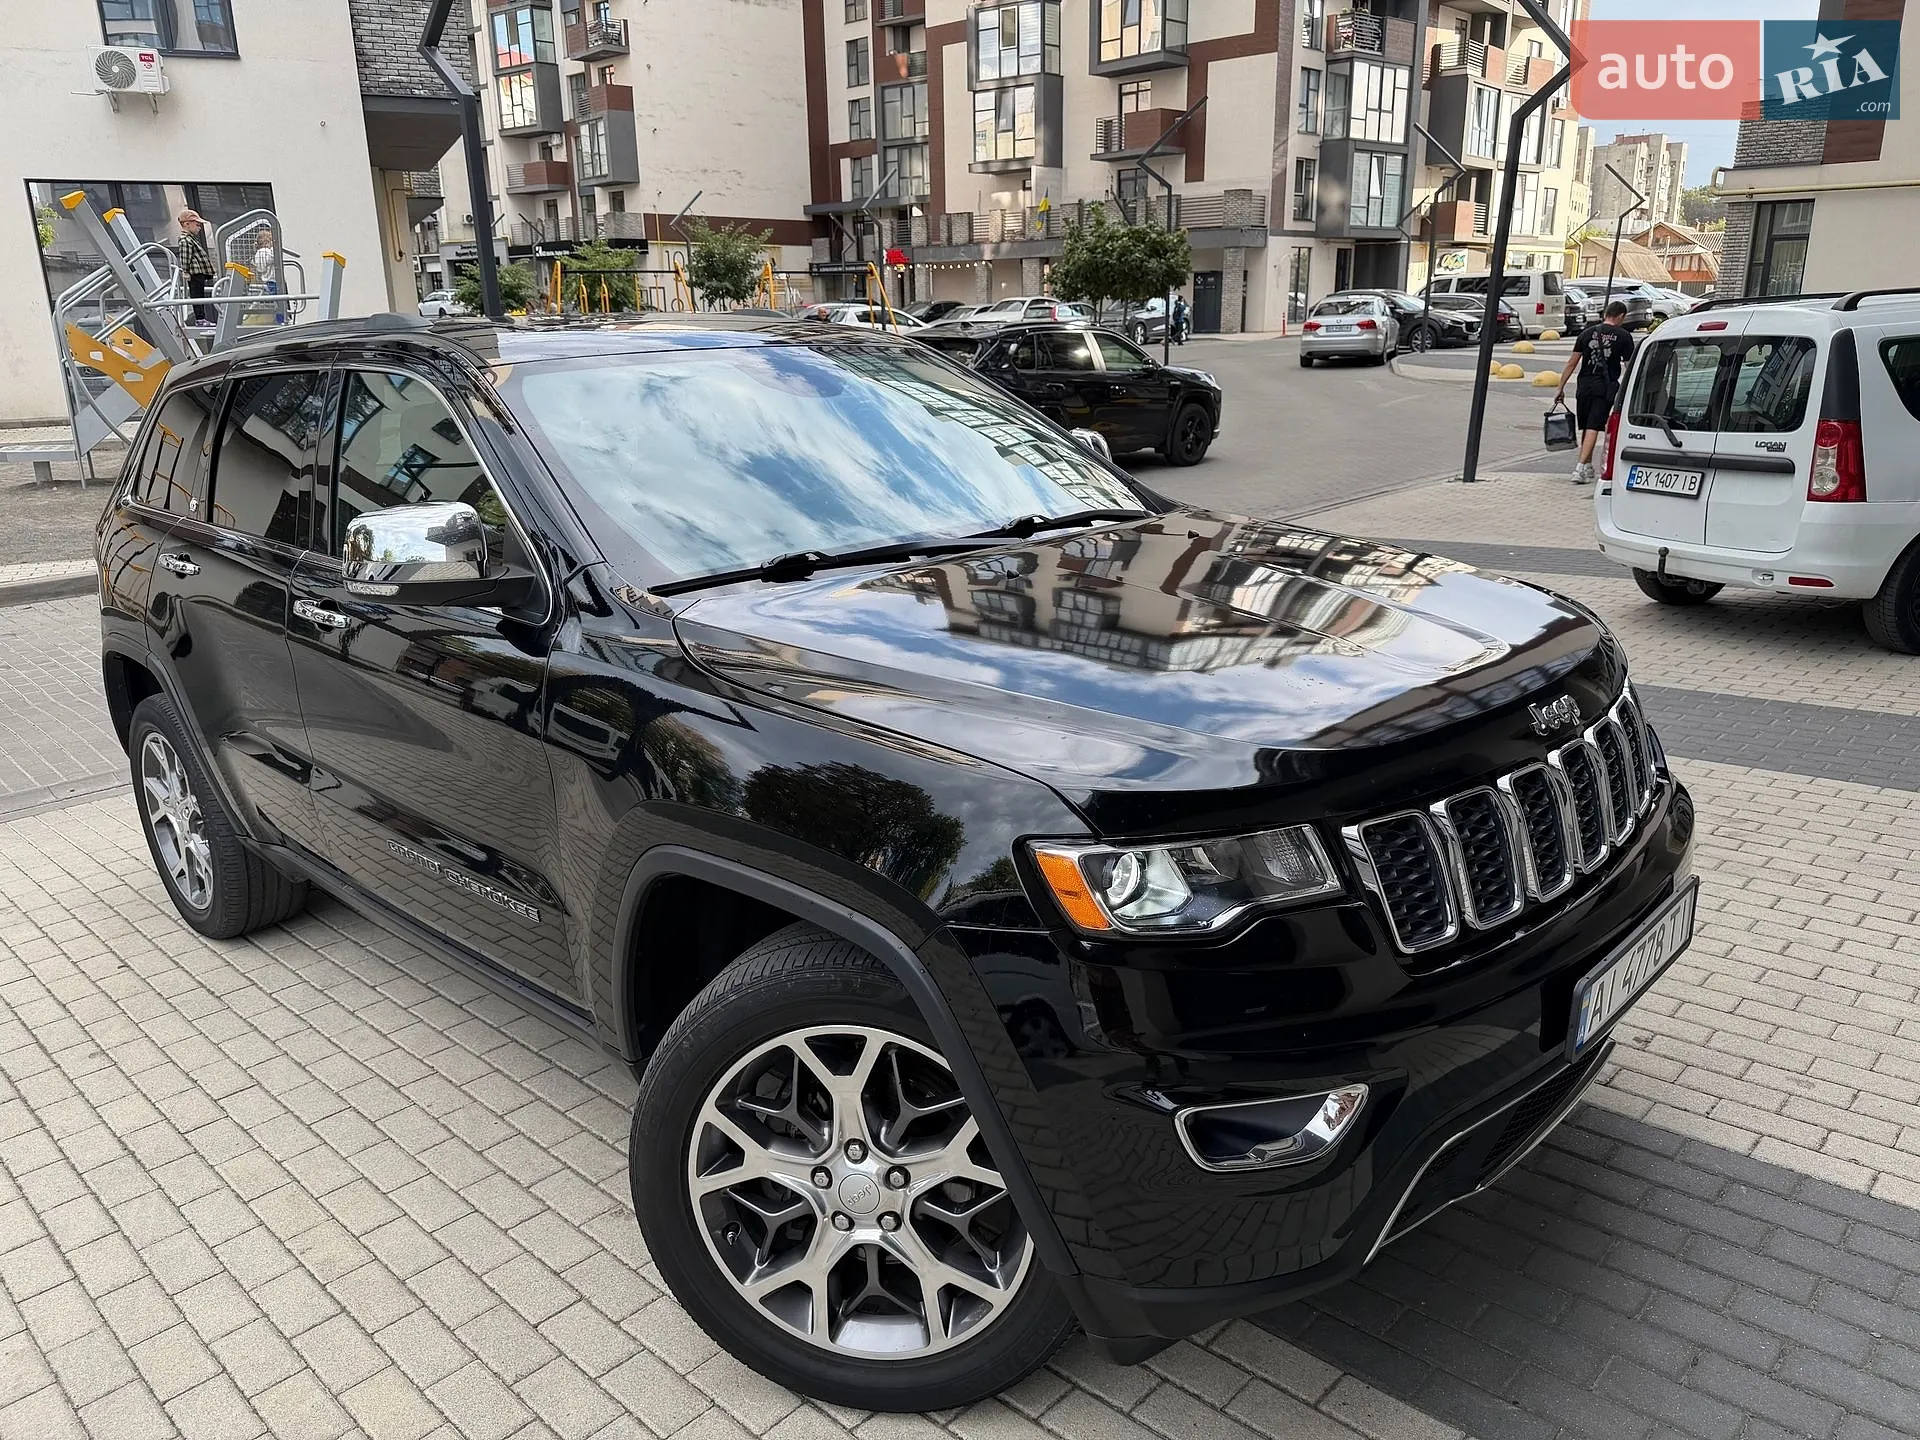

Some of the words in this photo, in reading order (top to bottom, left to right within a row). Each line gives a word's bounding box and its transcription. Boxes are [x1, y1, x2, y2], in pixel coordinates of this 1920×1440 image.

[1754, 440, 1787, 450] LOGAN
[1635, 470, 1653, 487] BX
[1654, 471, 1680, 489] 1407
[1681, 474, 1698, 491] IB
[1527, 694, 1581, 736] Jeep
[387, 839, 440, 874] GRAND
[444, 868, 543, 923] CHEROKEE
[1587, 969, 1617, 1034] AI
[1621, 923, 1666, 995] 4778
[1669, 899, 1688, 952] TI
